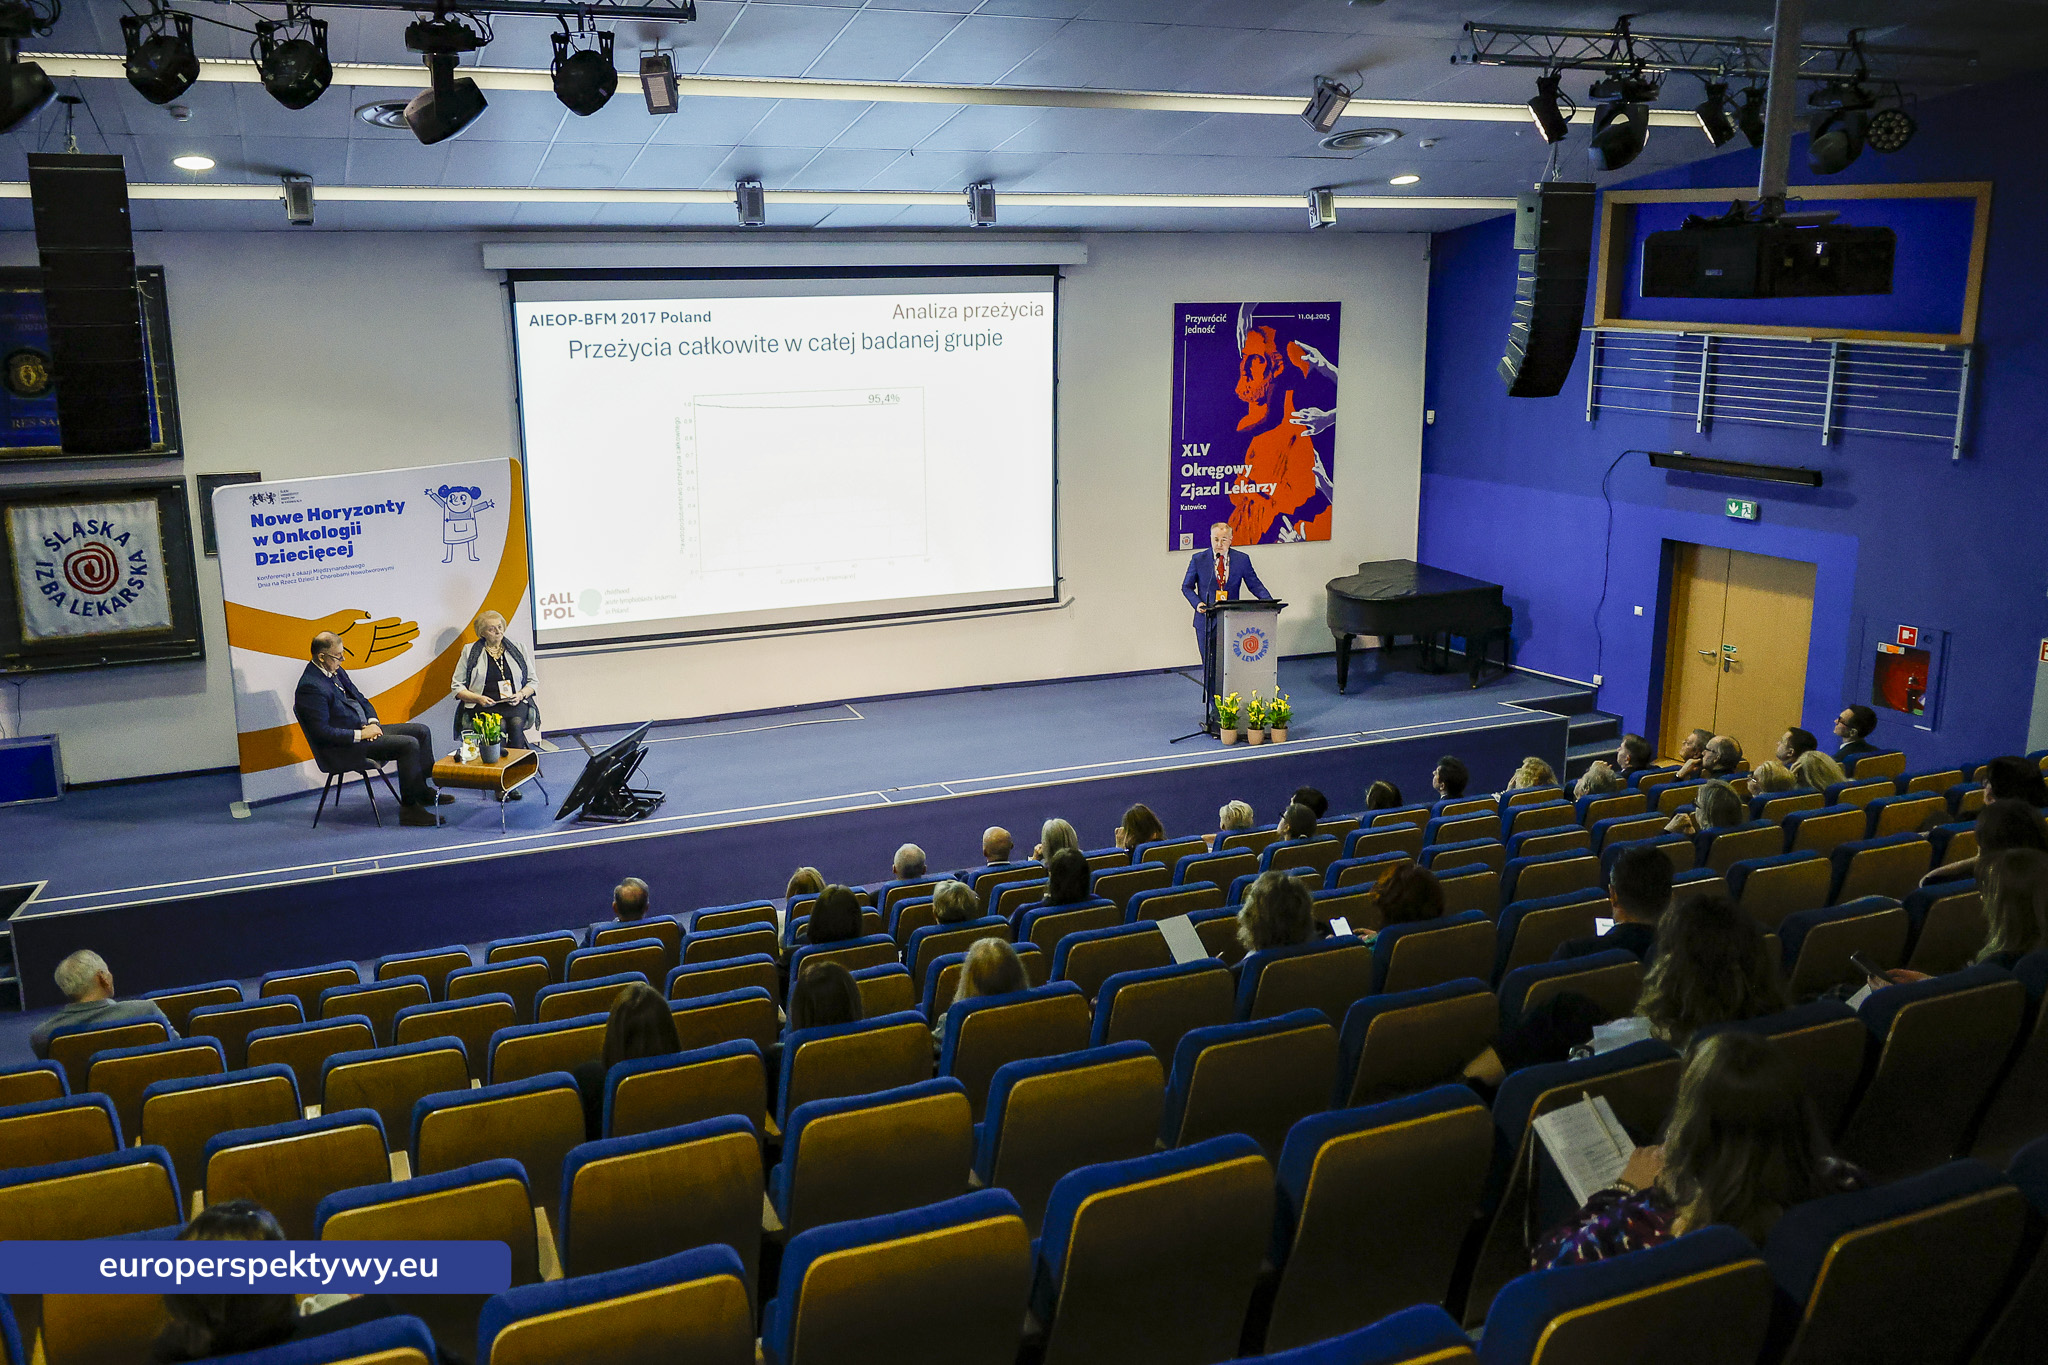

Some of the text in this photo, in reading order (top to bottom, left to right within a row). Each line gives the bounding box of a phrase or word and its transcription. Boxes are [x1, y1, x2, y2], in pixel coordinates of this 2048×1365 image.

[529, 310, 712, 327] AIEOP-BFM 2017 Poland
[892, 301, 1044, 322] Analiza przeżycia
[1185, 313, 1227, 325] Przywrócić
[1298, 313, 1331, 321] 11.04.2025
[1184, 324, 1216, 336] Jedność
[568, 328, 1003, 362] Przeżycia całkowite w całej badanej grupie
[868, 393, 901, 405] 95,4%
[1181, 442, 1211, 457] XLV
[1181, 462, 1253, 480] Okręgowy
[1180, 480, 1278, 501] Zjazd Lekarzy
[250, 499, 406, 528] Nowe Horyzonty
[1180, 503, 1207, 511] Katowice
[252, 521, 362, 547] w Onkologii
[254, 541, 354, 566] Dziecięcej
[257, 572, 291, 581] Konferencja
[313, 563, 366, 574] Międzynarodowego
[257, 581, 271, 589] Dnia
[280, 578, 297, 586] Rzecz
[297, 575, 315, 583] Dzieci
[319, 570, 350, 580] Chorobami
[351, 565, 395, 577] Nowotworowymi
[35, 549, 148, 617] IZBA LEKARSKA
[543, 606, 575, 620] POL
